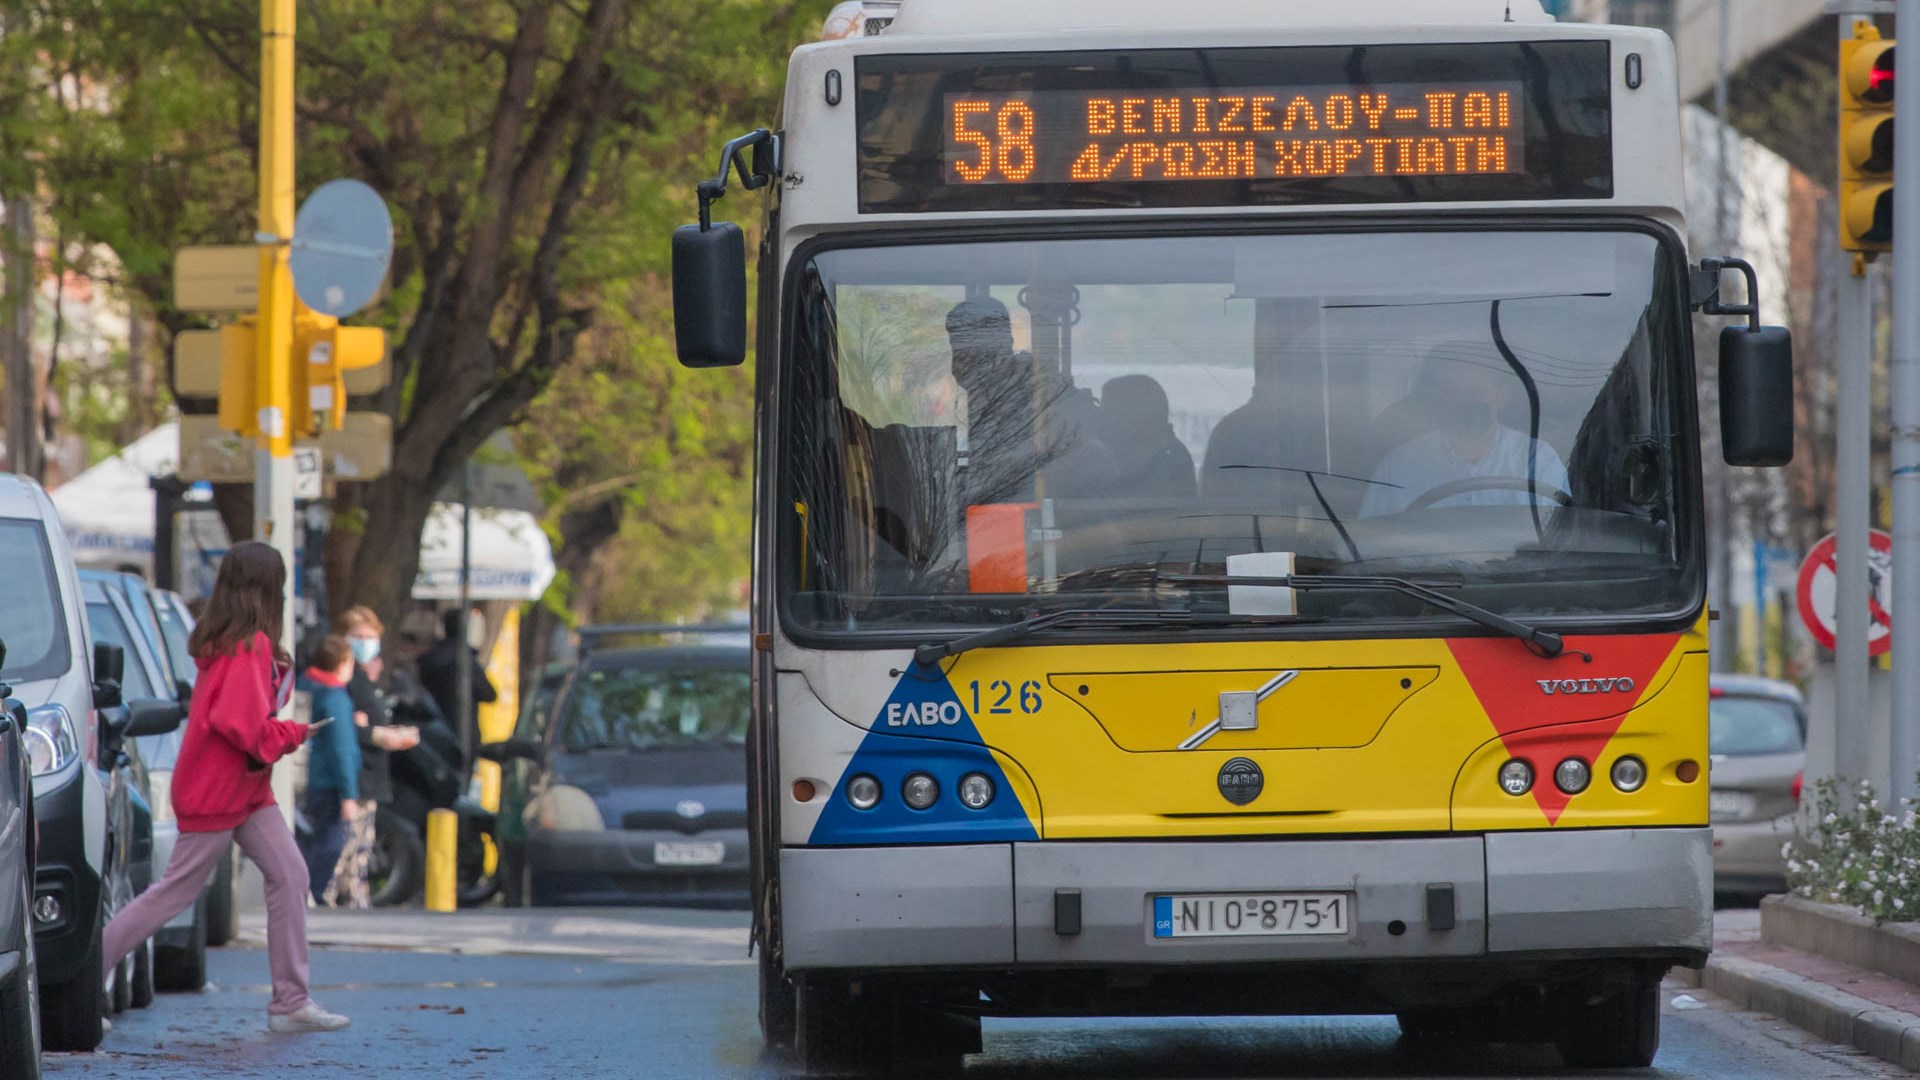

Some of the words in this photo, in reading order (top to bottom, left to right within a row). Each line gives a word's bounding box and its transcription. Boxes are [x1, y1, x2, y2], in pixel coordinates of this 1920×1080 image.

[953, 100, 1034, 181] 58
[1071, 139, 1255, 179] Δ/ΡΩΣΗ
[1274, 136, 1506, 176] ΧΟΡΤΙΑΤΗ
[969, 680, 1043, 715] 126
[1537, 677, 1634, 694] VOLVO
[887, 700, 962, 727] ΕΛΒΟ
[1156, 920, 1171, 930] GR
